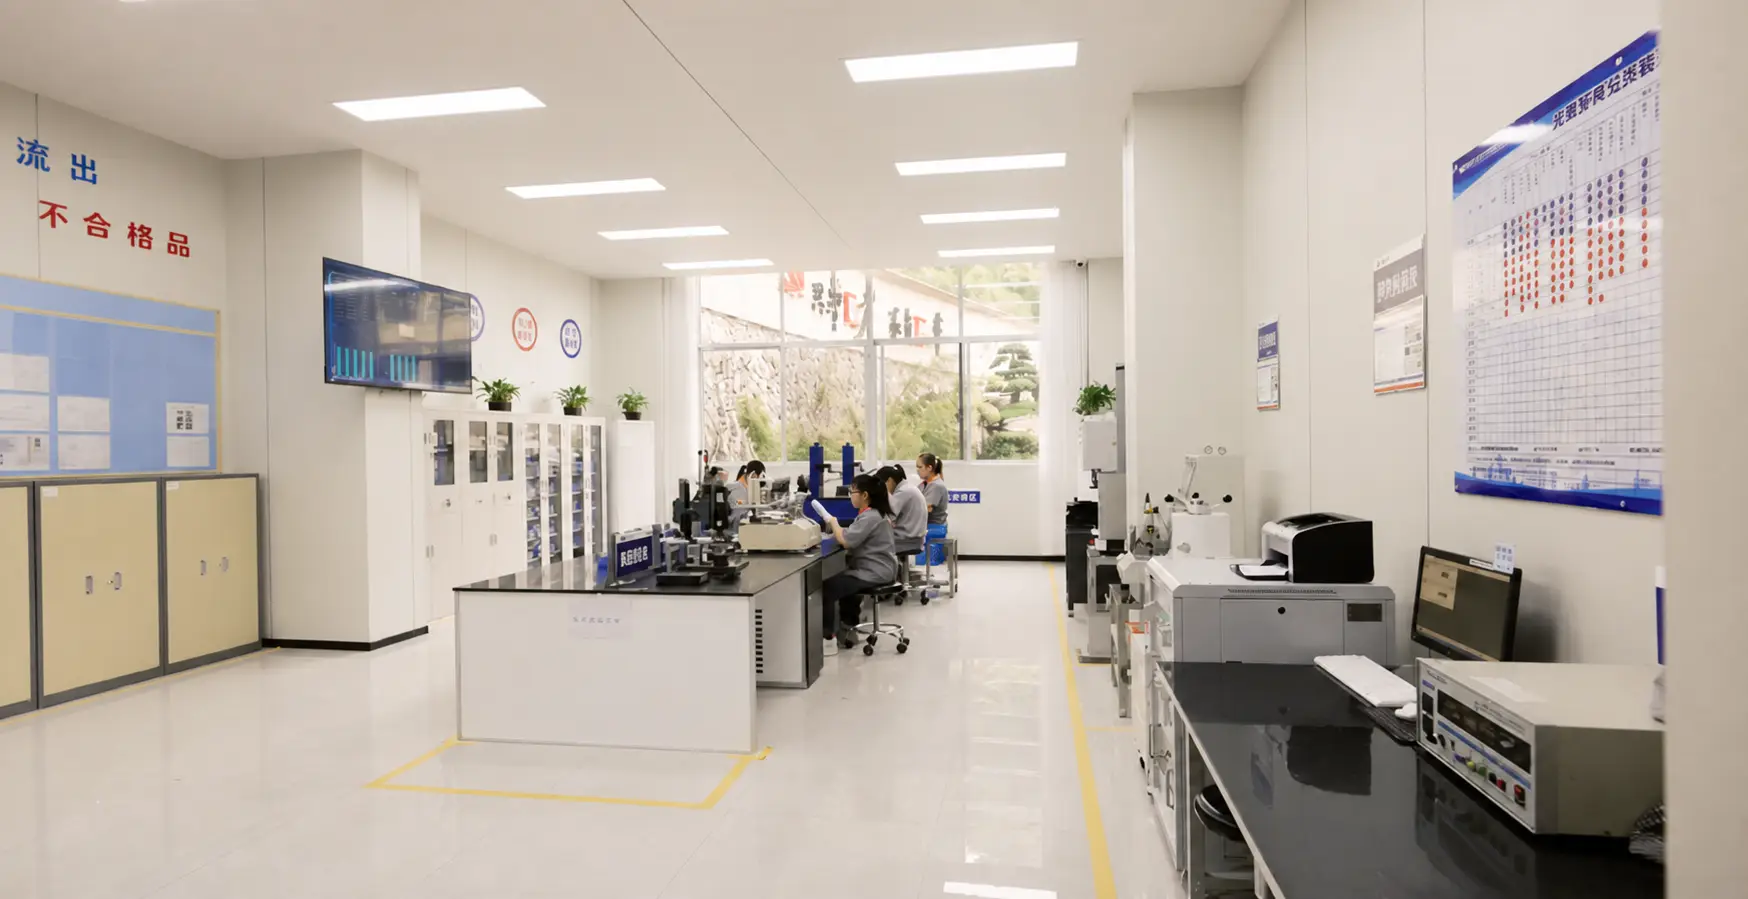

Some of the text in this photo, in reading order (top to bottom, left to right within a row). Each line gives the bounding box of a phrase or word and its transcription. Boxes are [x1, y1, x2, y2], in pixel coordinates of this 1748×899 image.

[16, 136, 98, 185] 流出
[38, 199, 191, 258] 不合格品
